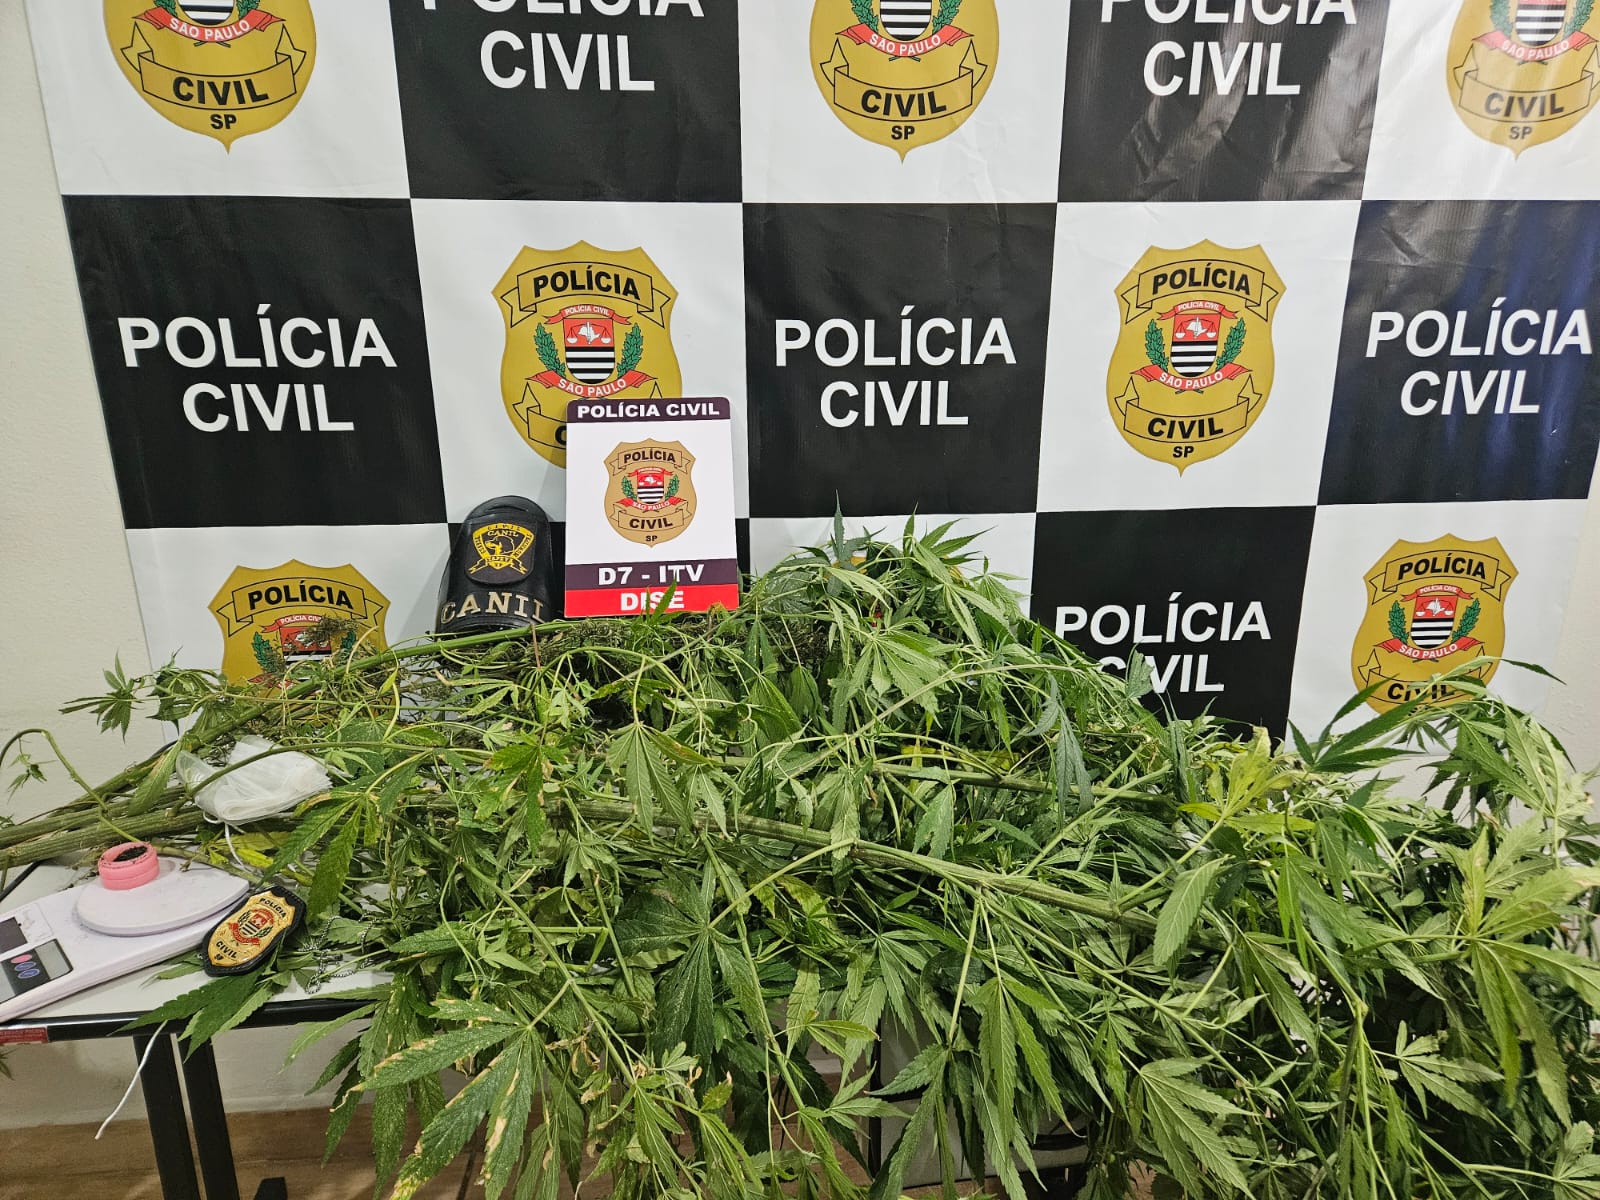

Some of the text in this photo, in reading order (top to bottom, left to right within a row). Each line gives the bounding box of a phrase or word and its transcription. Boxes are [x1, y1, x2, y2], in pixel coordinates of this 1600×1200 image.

[204, 20, 250, 40] PAULO
[899, 34, 941, 56] PAULO
[1527, 40, 1569, 60] PAULO
[480, 30, 656, 91] CIVIL
[1143, 40, 1301, 97] CIVIL
[172, 76, 269, 106] CIVIL
[861, 89, 947, 117] CIVIL
[1484, 92, 1565, 118] CIVIL
[210, 113, 237, 130] SP
[890, 125, 915, 140] SP
[1508, 125, 1533, 140] SP
[533, 265, 640, 300] POLÍCIA
[1151, 262, 1250, 296] POLÍCIA
[117, 303, 398, 368] POLÍCIA
[775, 305, 1017, 367] POLÍCIA
[1364, 296, 1593, 358] POLÍCIA
[587, 378, 626, 397] PAULO
[1185, 371, 1223, 389] PAULO
[1400, 369, 1540, 416] CIVIL
[182, 382, 355, 432] CIVIL
[577, 402, 720, 418] POLÍCIA CIVIL
[820, 380, 969, 428] CIVIL
[1147, 417, 1224, 439] CIVIL
[1172, 445, 1194, 458] SP
[629, 517, 673, 530] CIVIL
[645, 534, 658, 542] SP
[598, 566, 633, 586] D7
[659, 564, 705, 583] ITV
[1397, 552, 1486, 580] POLÍCIA
[247, 580, 354, 610] POLÍCIA
[1055, 591, 1272, 645] POLÍCIA
[1422, 643, 1458, 659] PAULO
[1100, 654, 1225, 693] VIL
[216, 941, 237, 958] CIVIL
